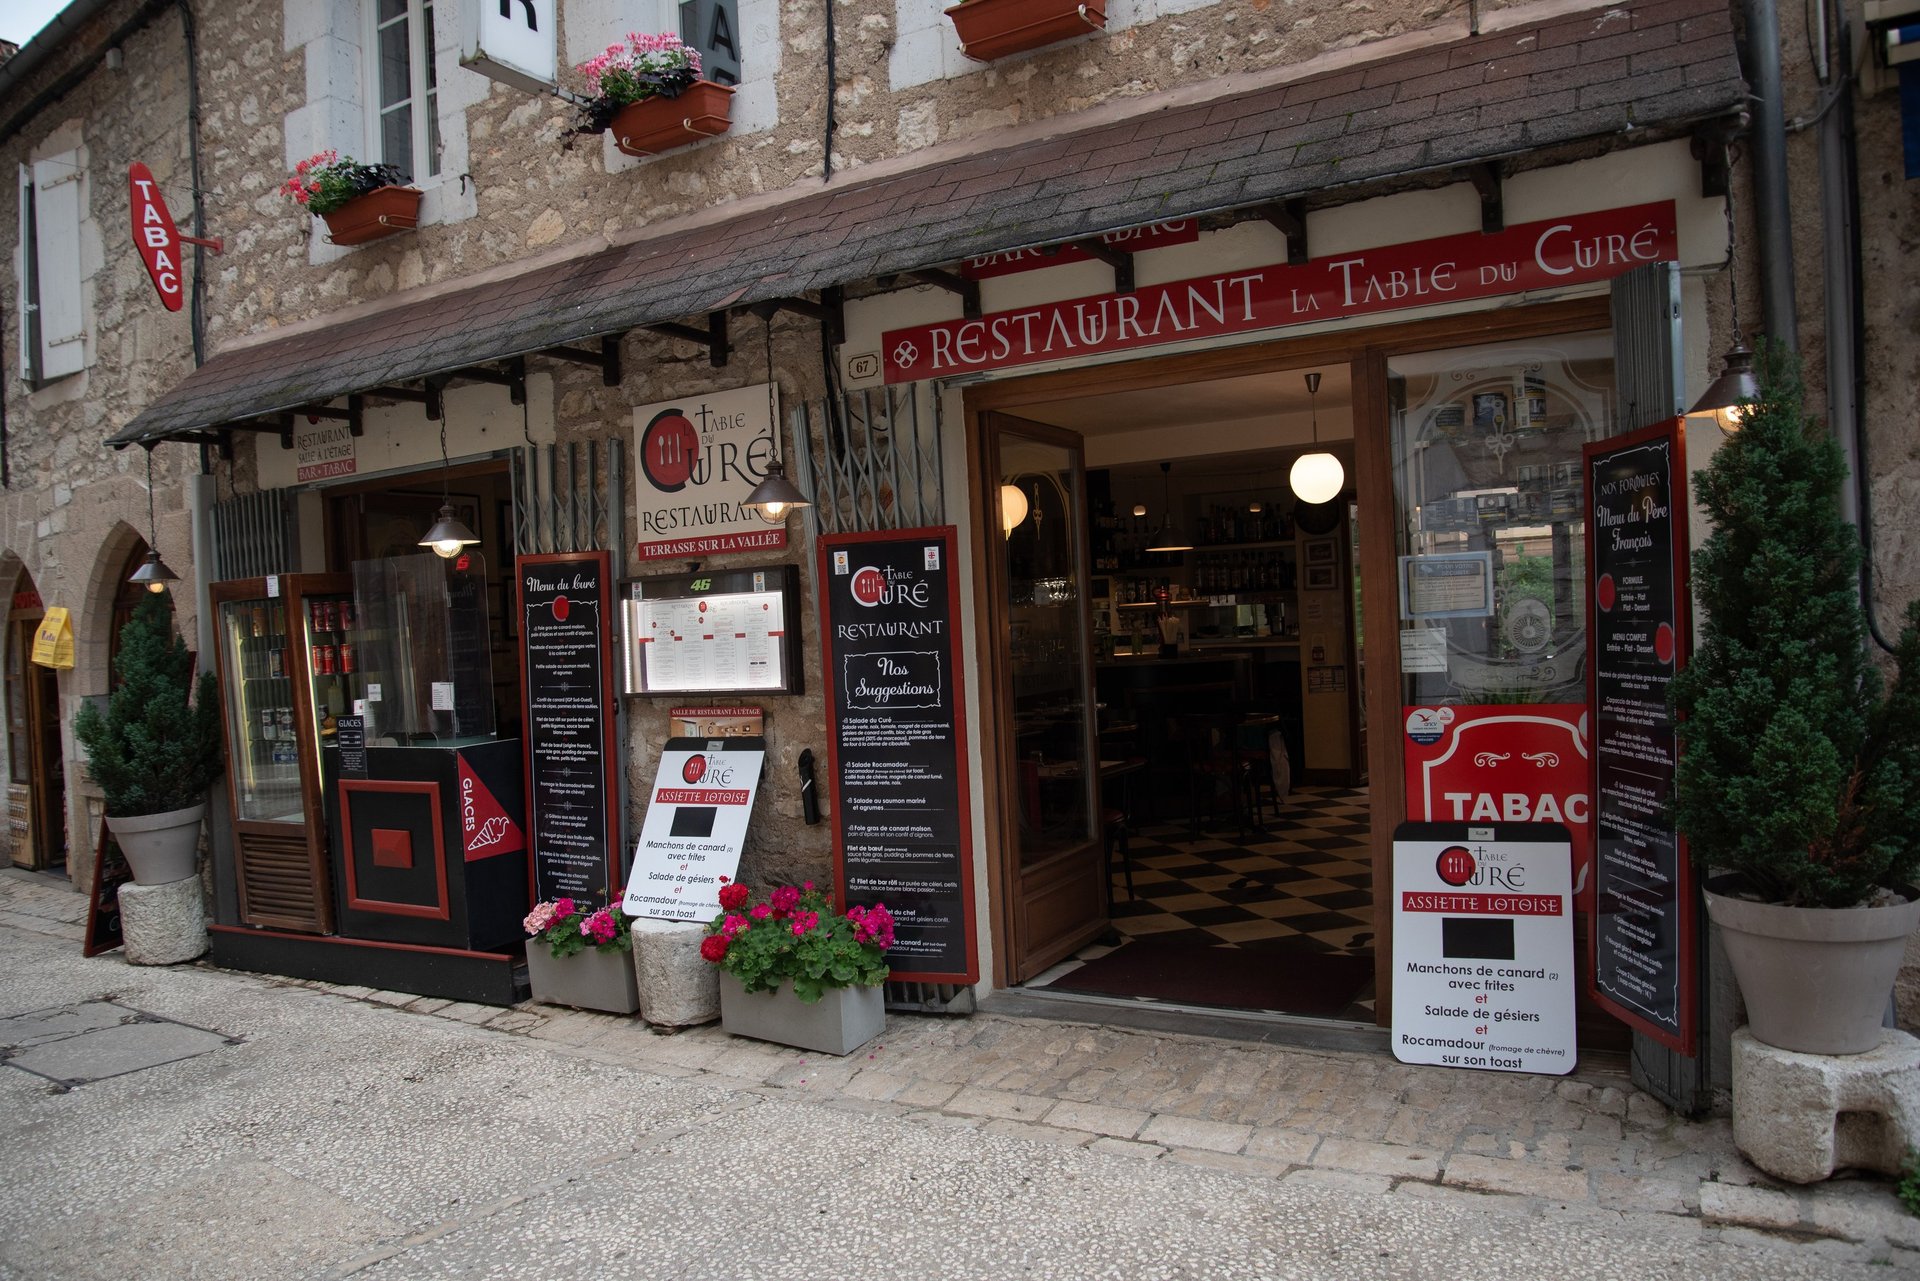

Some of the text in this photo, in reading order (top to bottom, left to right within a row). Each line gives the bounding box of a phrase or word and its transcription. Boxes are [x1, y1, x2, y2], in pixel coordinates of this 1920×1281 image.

[135, 180, 178, 293] TABAC
[929, 273, 1264, 370] RESTAURANT
[1328, 258, 1458, 306] TABLE
[1480, 261, 1517, 286] DU
[1535, 223, 1660, 276] CURÉ
[855, 360, 868, 374] 67
[695, 404, 745, 433] TABLE
[297, 426, 350, 451] RESTAURANT
[300, 460, 352, 480] BAR TABAC
[642, 501, 765, 535] RESTAURAN
[1597, 496, 1668, 528] Menu du Père
[643, 531, 780, 556] TERRASSE SUR LA VALLÉE
[1612, 528, 1652, 552] François
[883, 565, 912, 580] TABLE
[1622, 576, 1643, 584] FORMULE
[527, 577, 554, 592] Menu
[557, 579, 568, 590] du
[690, 579, 711, 591] 46
[851, 566, 929, 608] CURÉ
[838, 620, 943, 641] RESTAURANT
[1612, 633, 1647, 642] MENU COMPLET
[877, 657, 909, 676] Nos
[855, 678, 934, 703] Suggestions
[338, 719, 361, 727] GLACES
[462, 778, 475, 831] GLACES
[658, 791, 746, 803] ASSIETTE LOTOISE
[1444, 793, 1588, 823] TABAC
[646, 841, 684, 850] Manchons
[686, 842, 696, 850] de
[698, 842, 726, 852] canard
[1474, 846, 1507, 861] TABLE
[688, 852, 706, 861] frites
[680, 863, 688, 871] et
[1436, 846, 1525, 892] CURÉ
[648, 872, 714, 885] Salade de gésiers
[674, 886, 682, 894] et
[630, 894, 677, 905] Rocamadour
[1406, 896, 1559, 913] ASSIETTE LOTOISE
[677, 910, 696, 918] toast
[1407, 962, 1559, 980] Manchons de canard (2)
[1448, 979, 1515, 992] avec frites
[1475, 994, 1488, 1004] et
[1425, 1005, 1540, 1022] Salade de gésiers
[1475, 1025, 1488, 1035] et
[1402, 1035, 1565, 1056] Rocamadour (fromage de chèvre)
[1442, 1055, 1522, 1068] sur son toast
